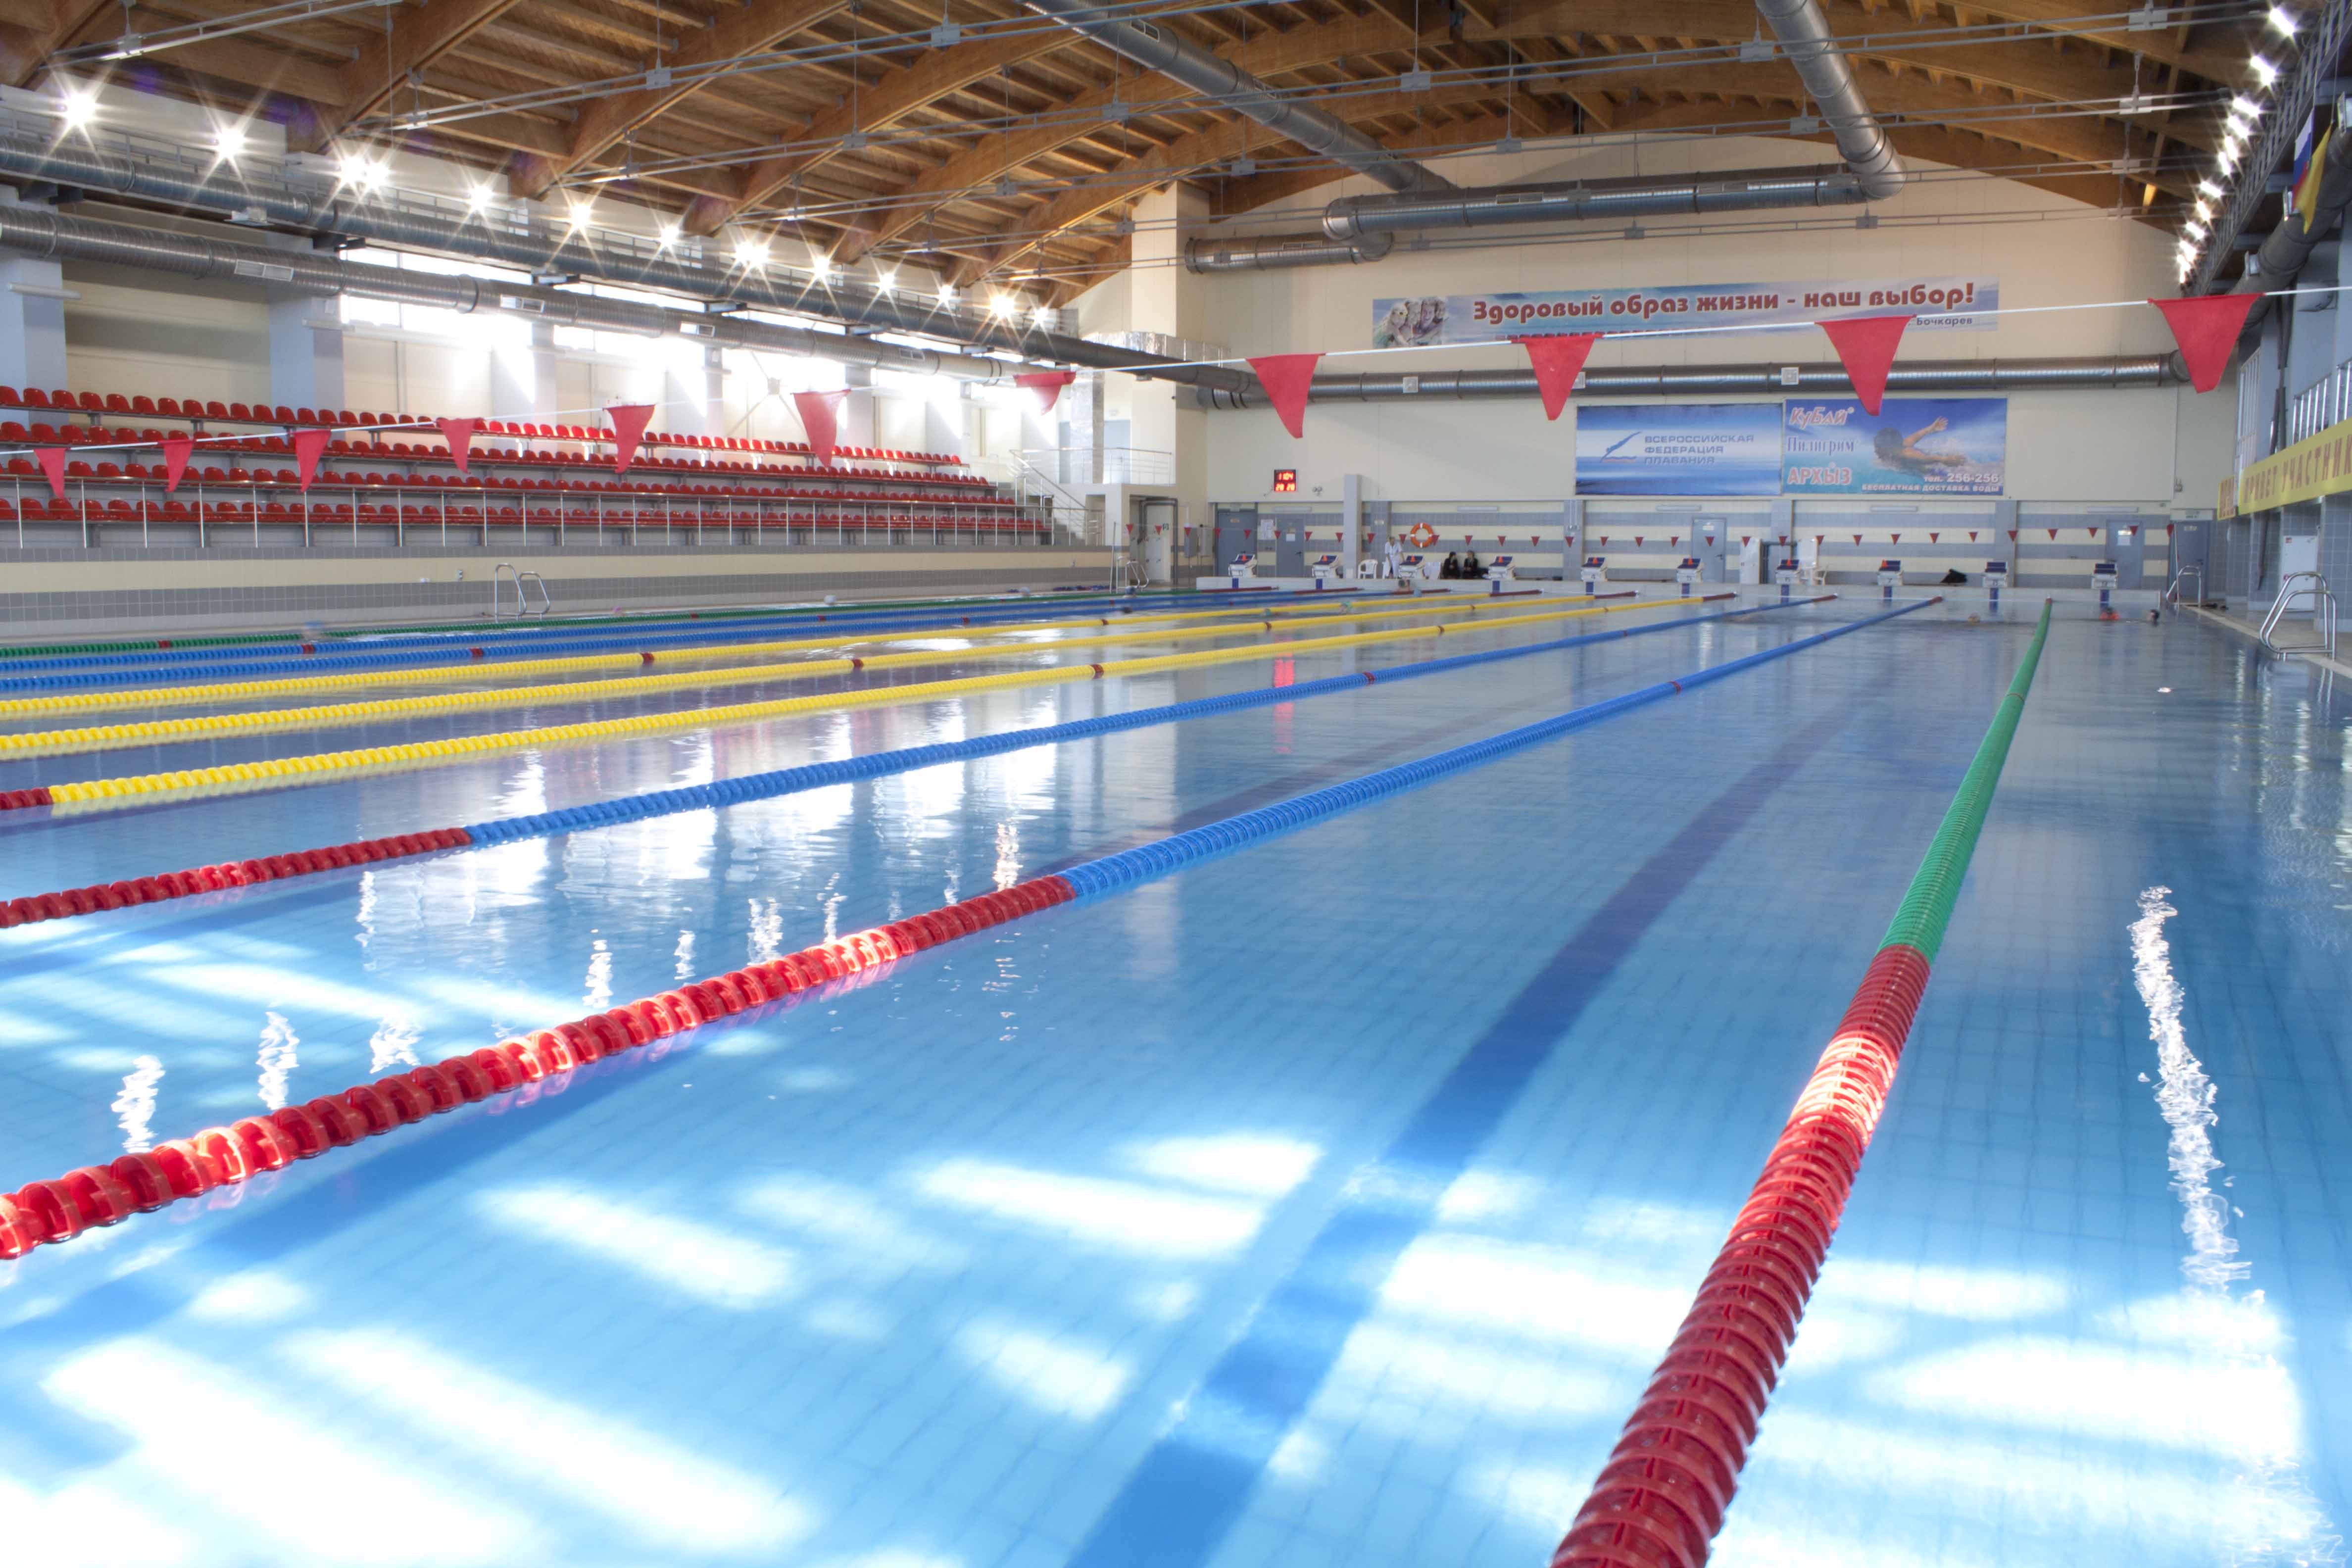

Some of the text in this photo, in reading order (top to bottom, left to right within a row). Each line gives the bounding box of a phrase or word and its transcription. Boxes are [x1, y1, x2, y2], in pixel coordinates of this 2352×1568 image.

[1473, 295, 1604, 325] Здоровый
[1610, 294, 1689, 319] образ
[1696, 294, 1778, 312] жизни
[1804, 291, 1862, 308] наш
[1868, 283, 1974, 309] выбор!
[1916, 317, 1972, 327] Бочкарев
[1644, 434, 1755, 443] ВСЕРОССИЙСКАЯ
[1644, 445, 1724, 454] ФЕДЕРАЦИЯ
[1787, 436, 1855, 456] Пилигрим
[1644, 456, 1715, 464] ПЛАВАНИЯ
[1787, 467, 1852, 486] АРХЫЗ
[1947, 473, 1999, 483] 256-256
